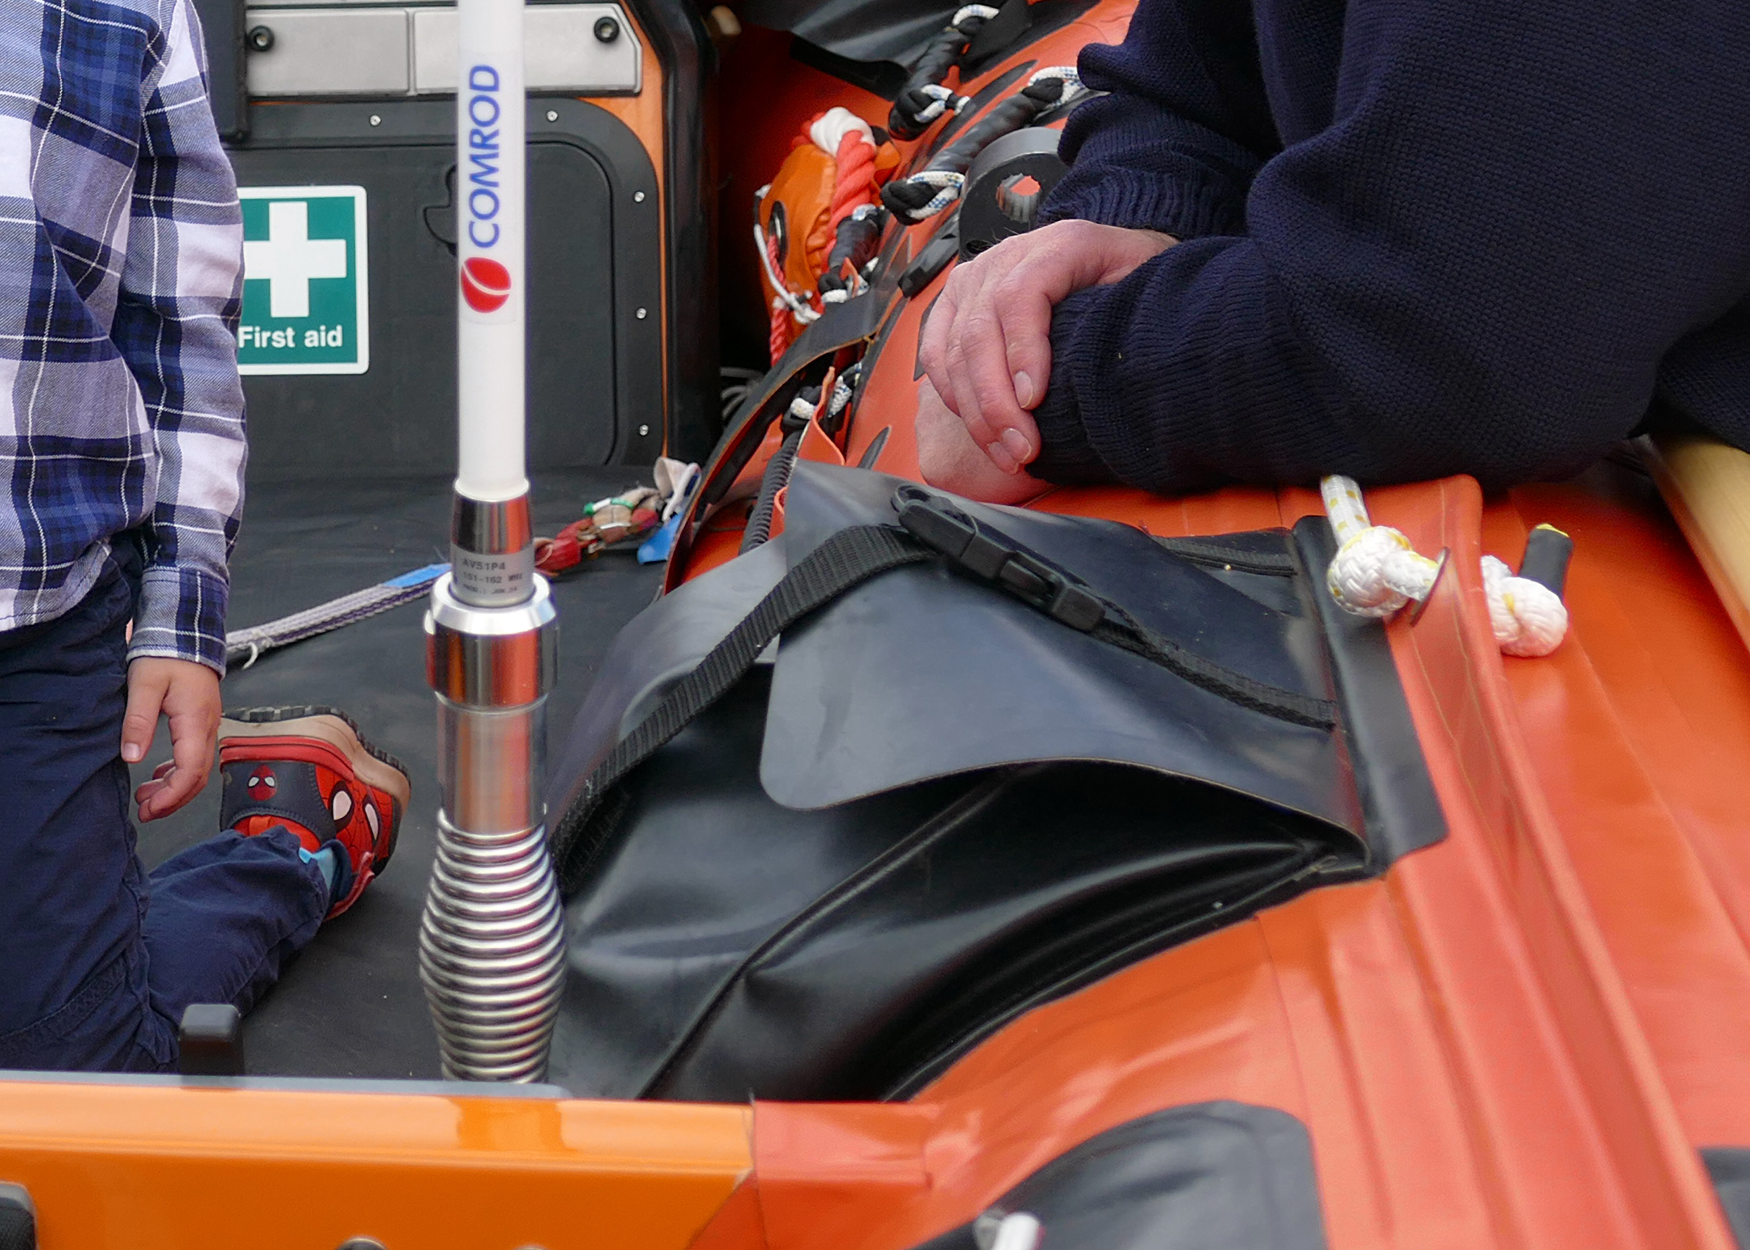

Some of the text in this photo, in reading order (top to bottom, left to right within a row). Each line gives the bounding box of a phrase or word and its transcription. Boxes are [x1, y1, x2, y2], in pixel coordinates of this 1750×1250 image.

[468, 64, 500, 249] COMROD
[238, 325, 343, 348] First aid
